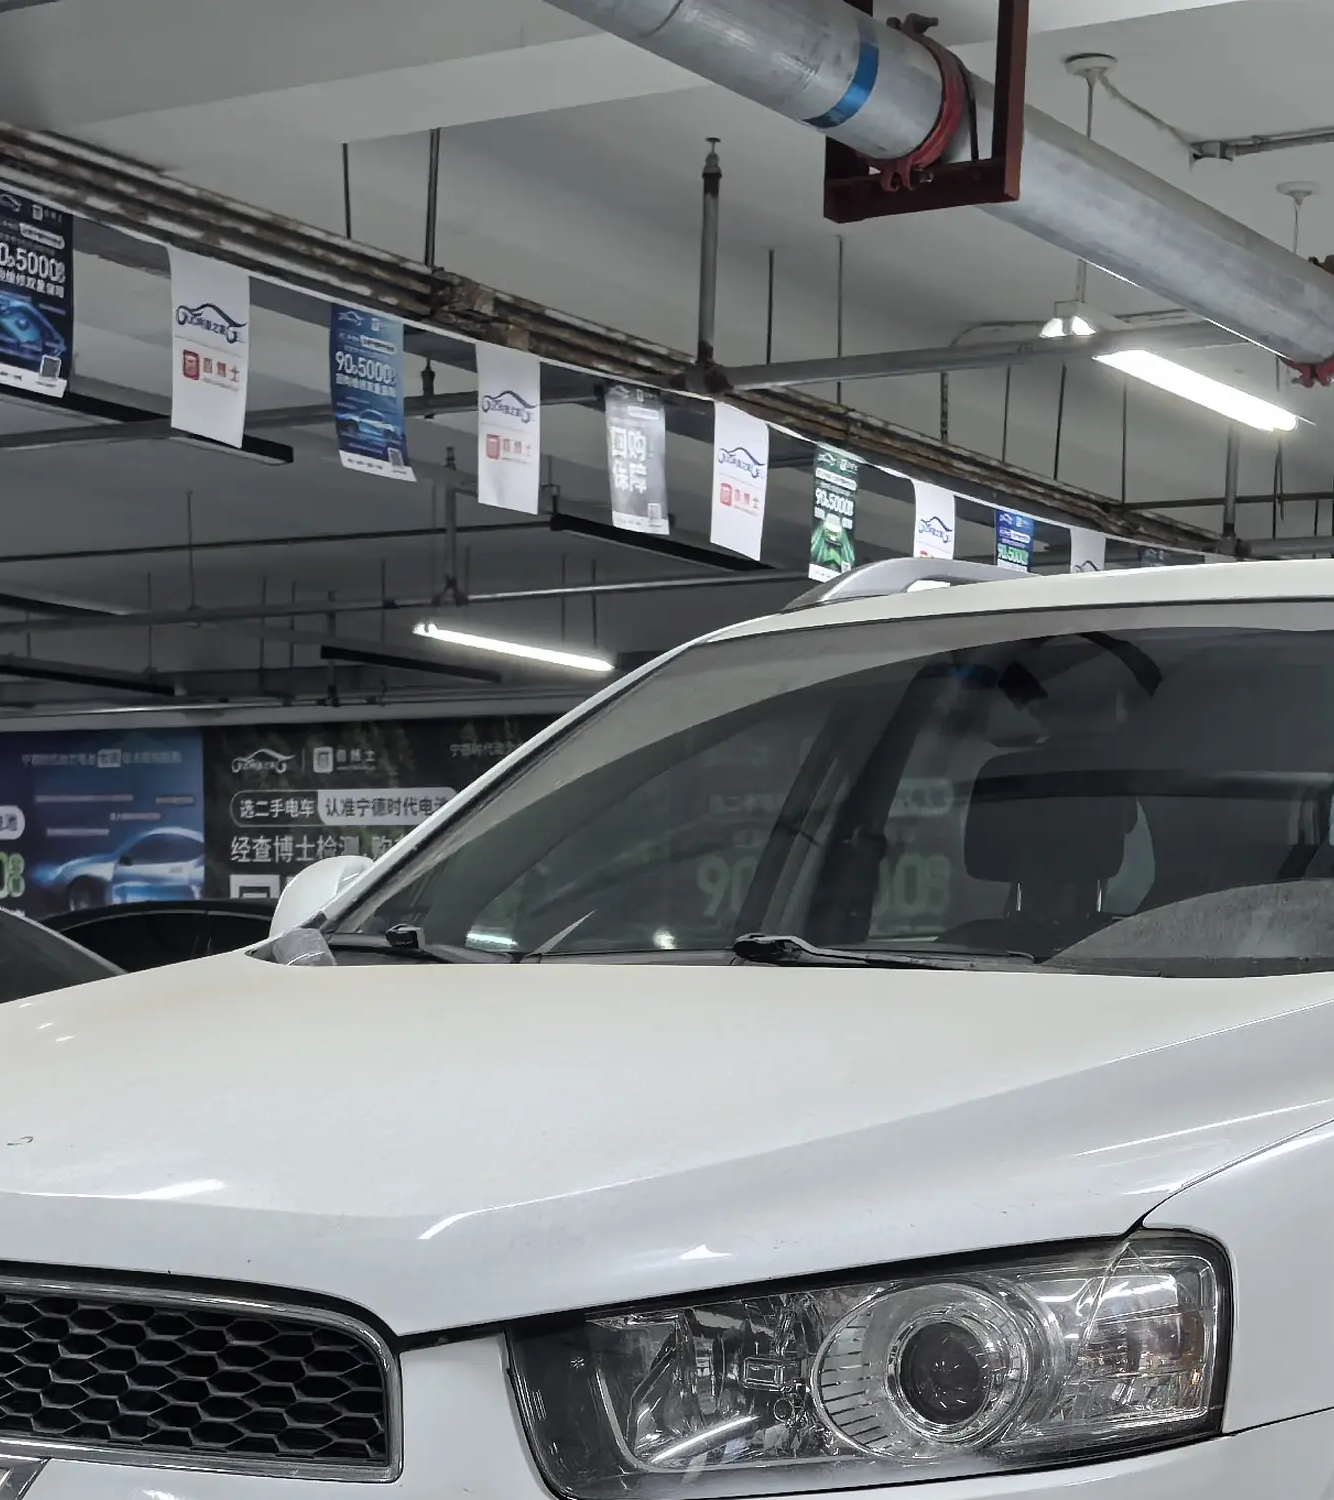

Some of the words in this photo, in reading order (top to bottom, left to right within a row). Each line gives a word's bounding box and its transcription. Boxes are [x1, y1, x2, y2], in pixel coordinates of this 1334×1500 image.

[239, 798, 315, 818] 选二手电车
